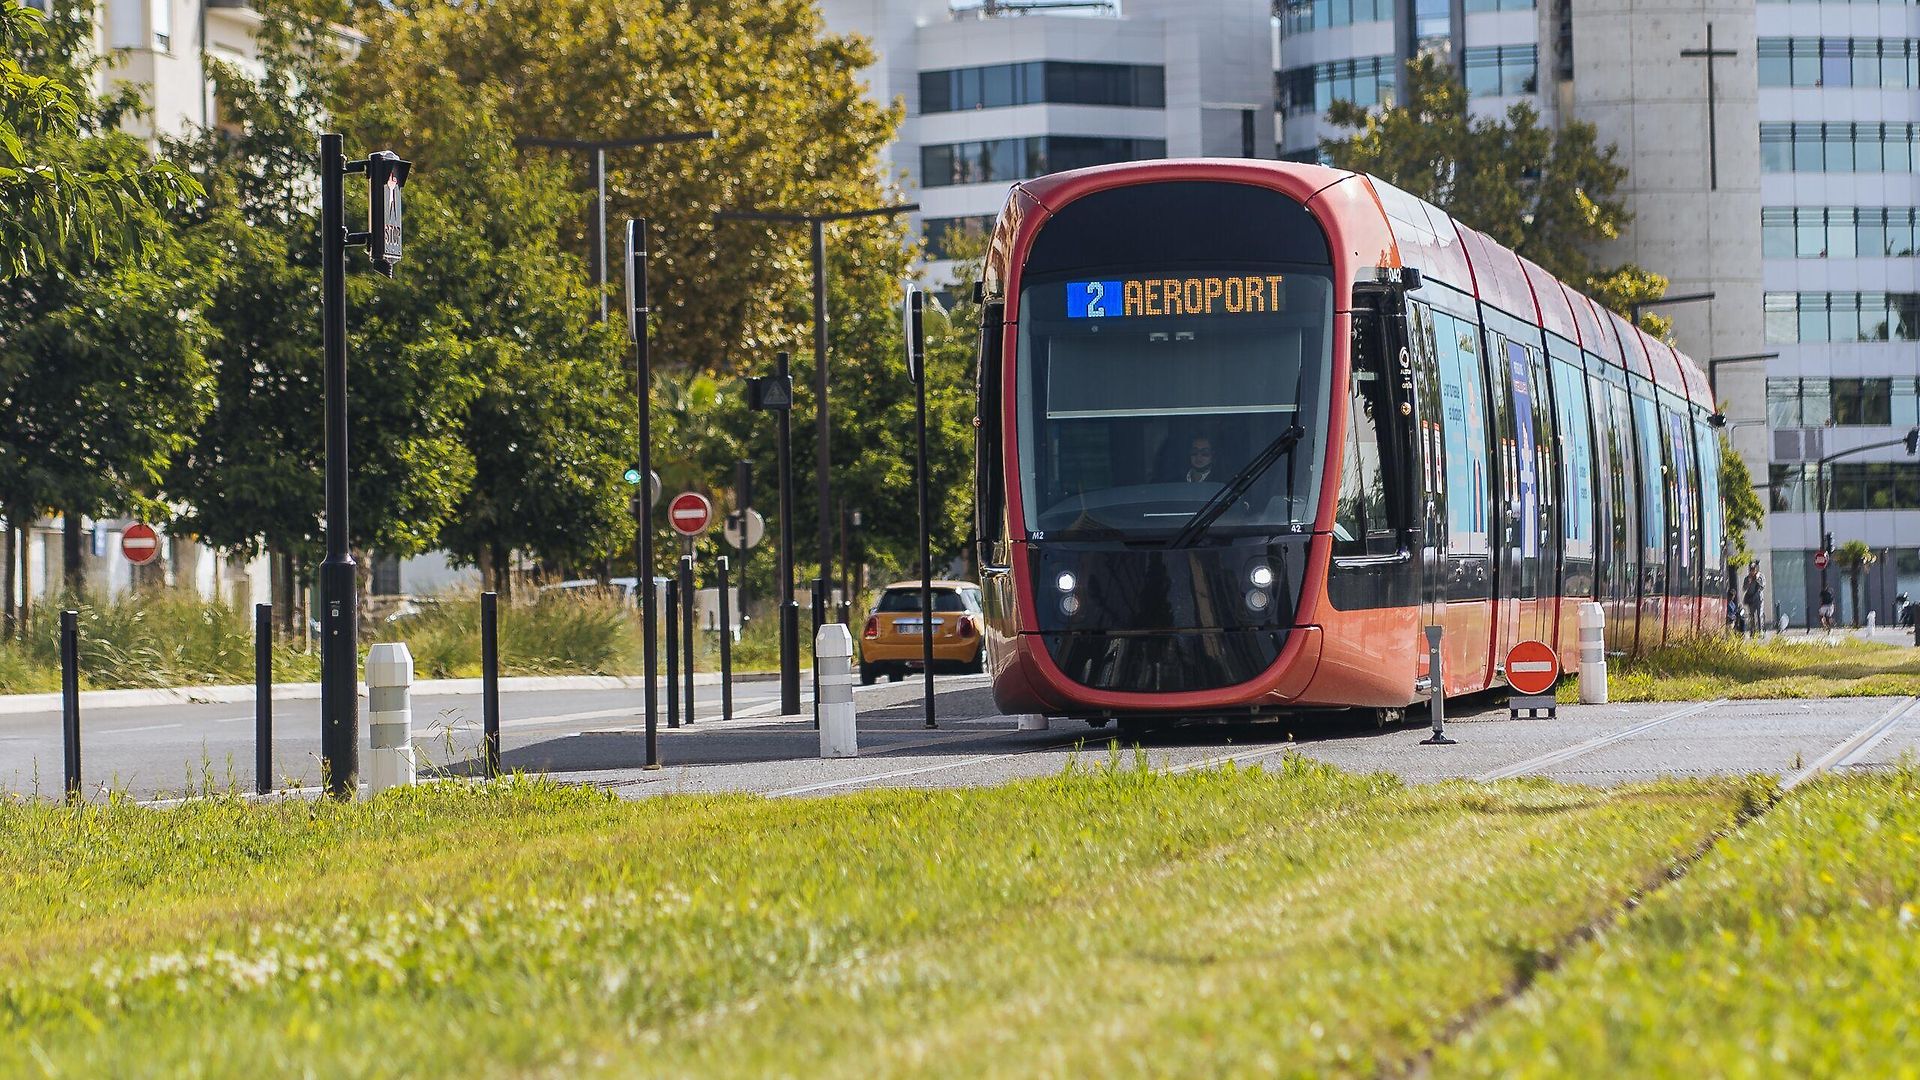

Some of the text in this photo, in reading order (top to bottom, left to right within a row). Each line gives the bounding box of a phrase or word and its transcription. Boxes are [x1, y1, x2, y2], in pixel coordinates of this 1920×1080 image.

[1388, 267, 1402, 283] 042
[1087, 275, 1283, 317] 2 AEROPORT
[1291, 524, 1302, 533] 42
[1032, 531, 1044, 540] M2
